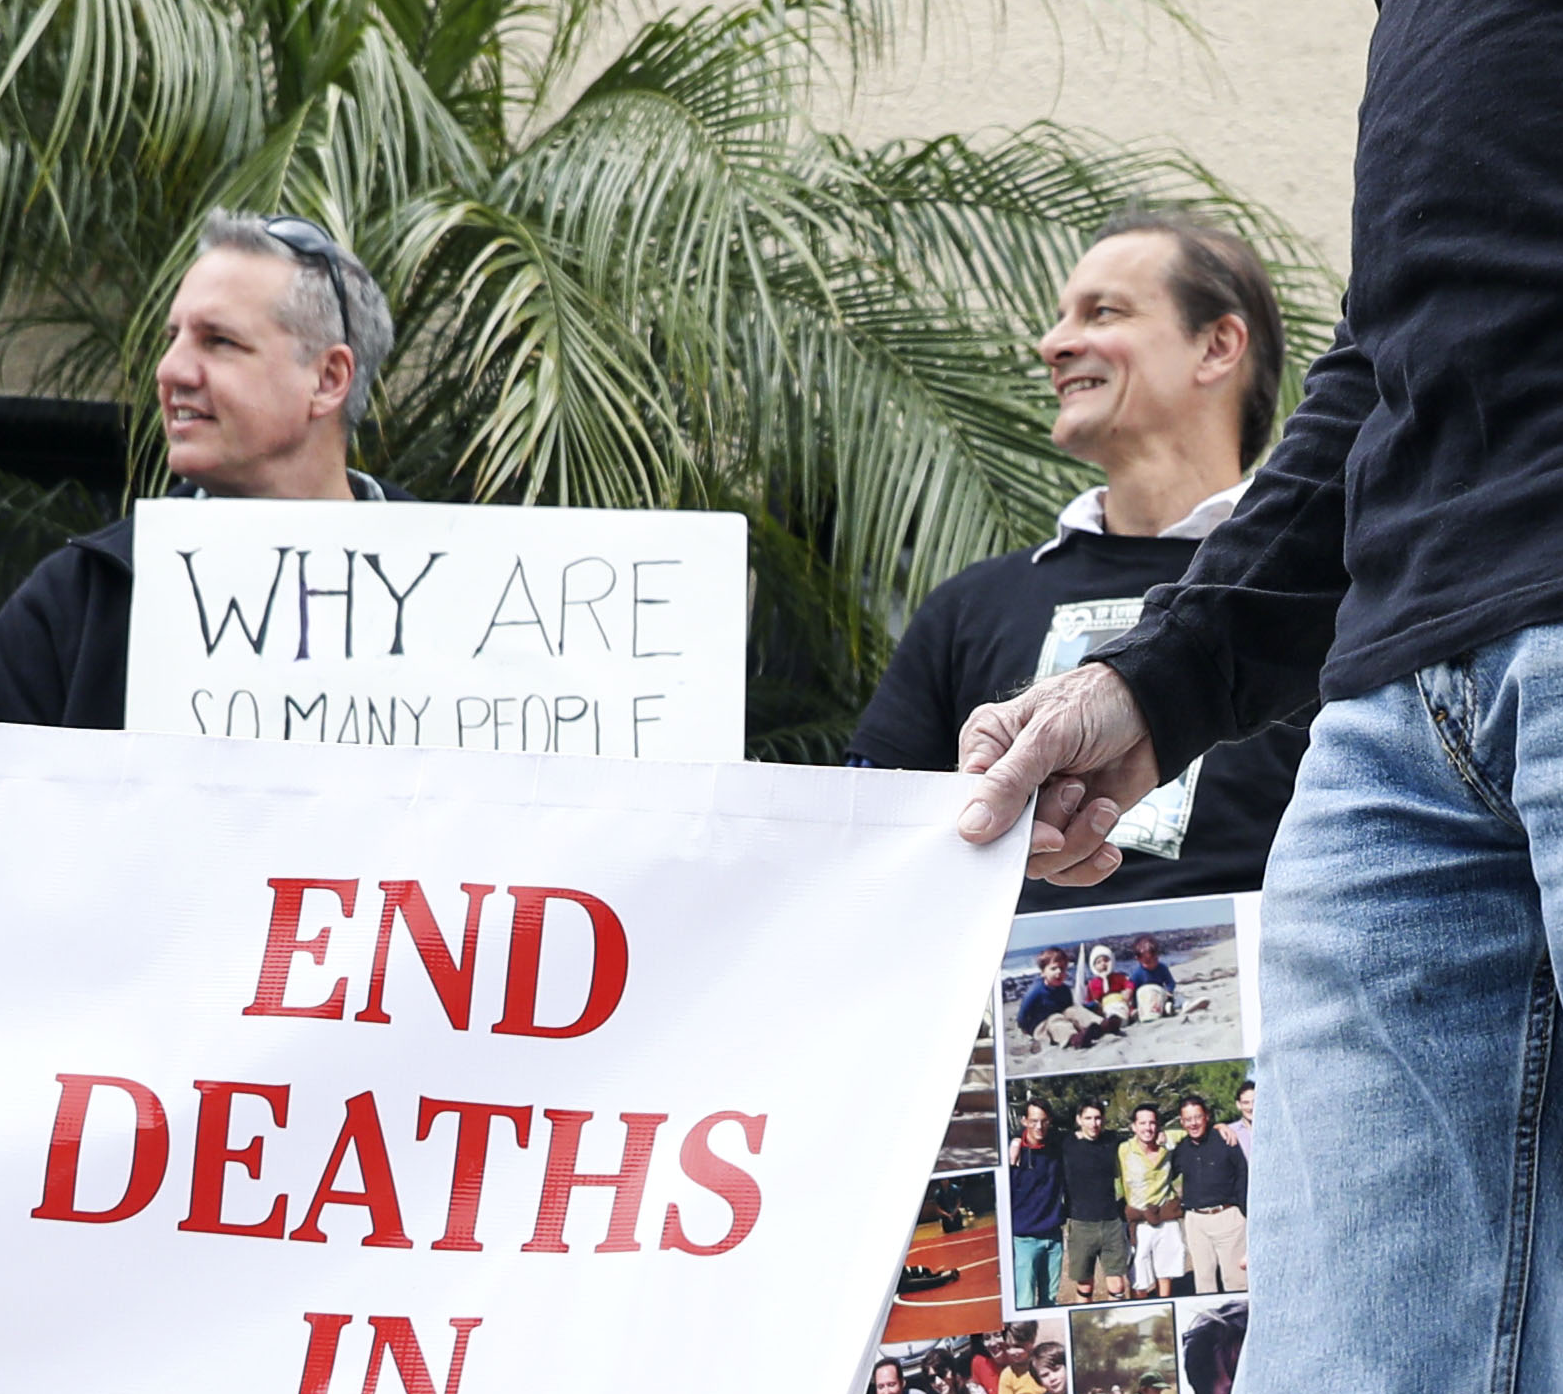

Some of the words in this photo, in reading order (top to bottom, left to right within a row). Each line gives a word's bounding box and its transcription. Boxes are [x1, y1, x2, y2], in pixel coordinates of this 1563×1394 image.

[176, 546, 448, 662] WHY
[472, 555, 684, 660] ARE
[241, 877, 630, 1040] END
[30, 1072, 768, 1257] DEATHS
